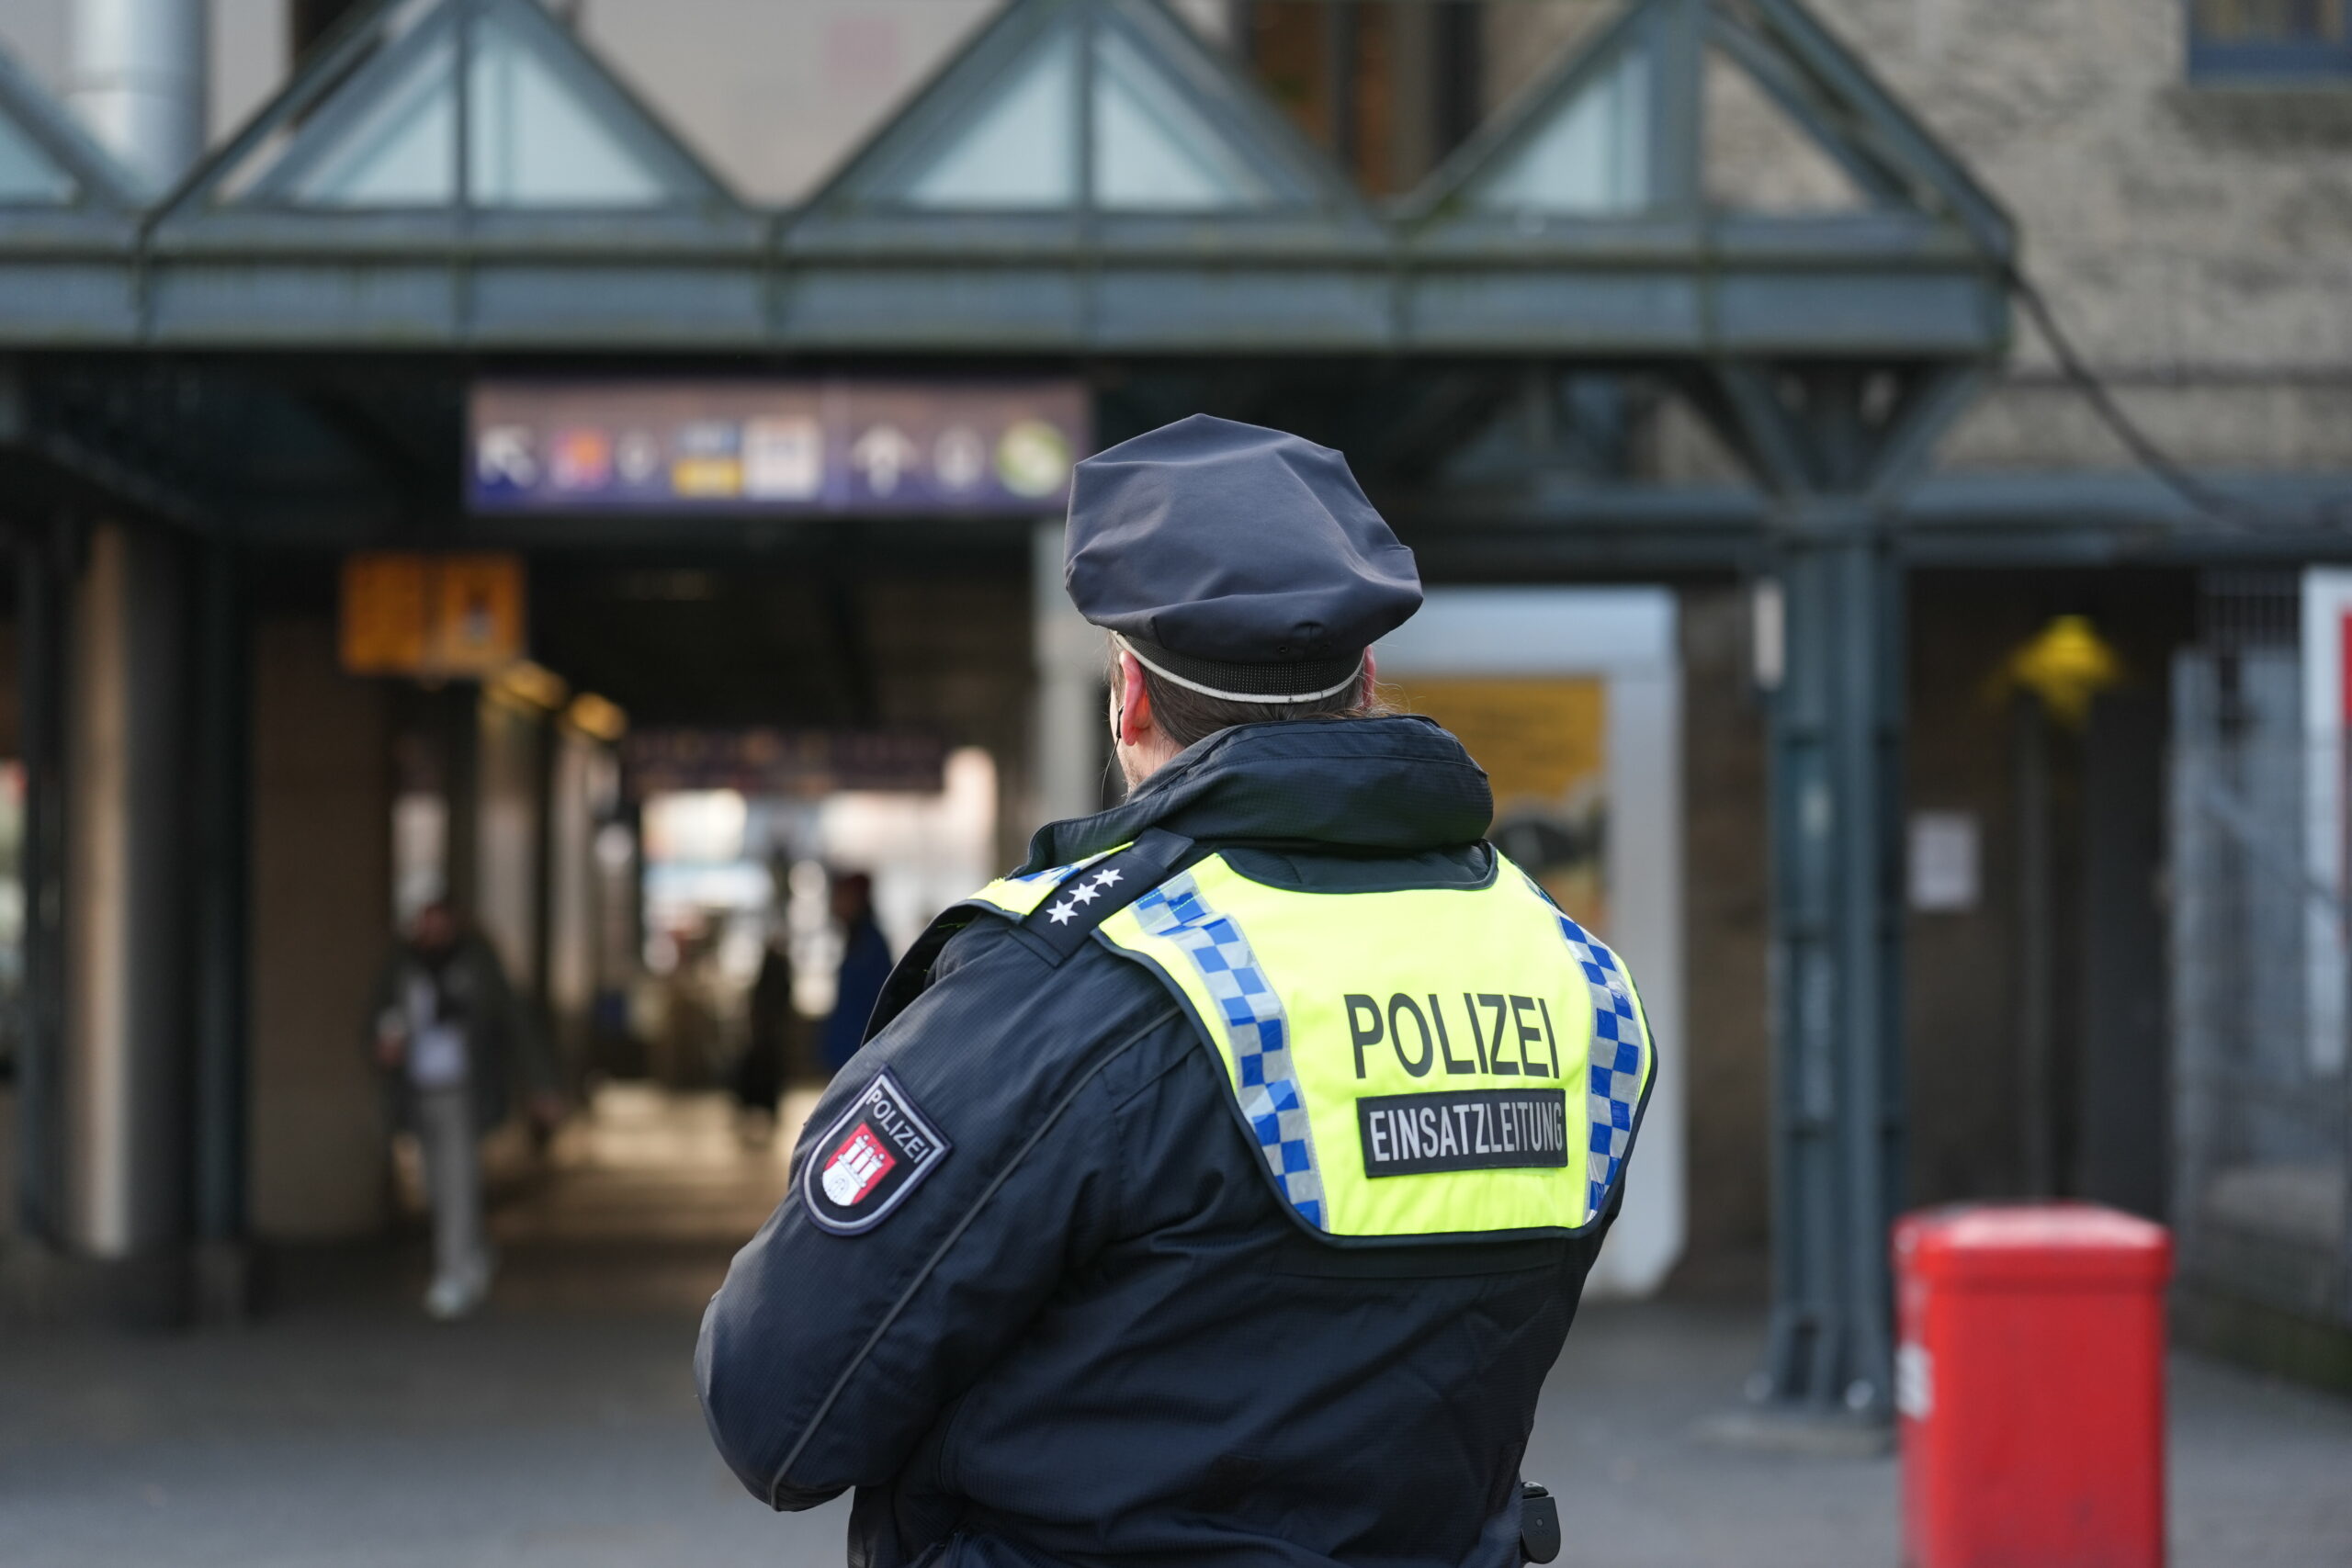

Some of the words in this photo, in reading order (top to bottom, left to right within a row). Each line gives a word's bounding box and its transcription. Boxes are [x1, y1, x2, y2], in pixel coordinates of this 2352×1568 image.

[1344, 992, 1560, 1079] POLIZEI
[865, 1089, 930, 1164] POLIZEI
[1369, 1101, 1563, 1162] EINSATZLEITUNG
